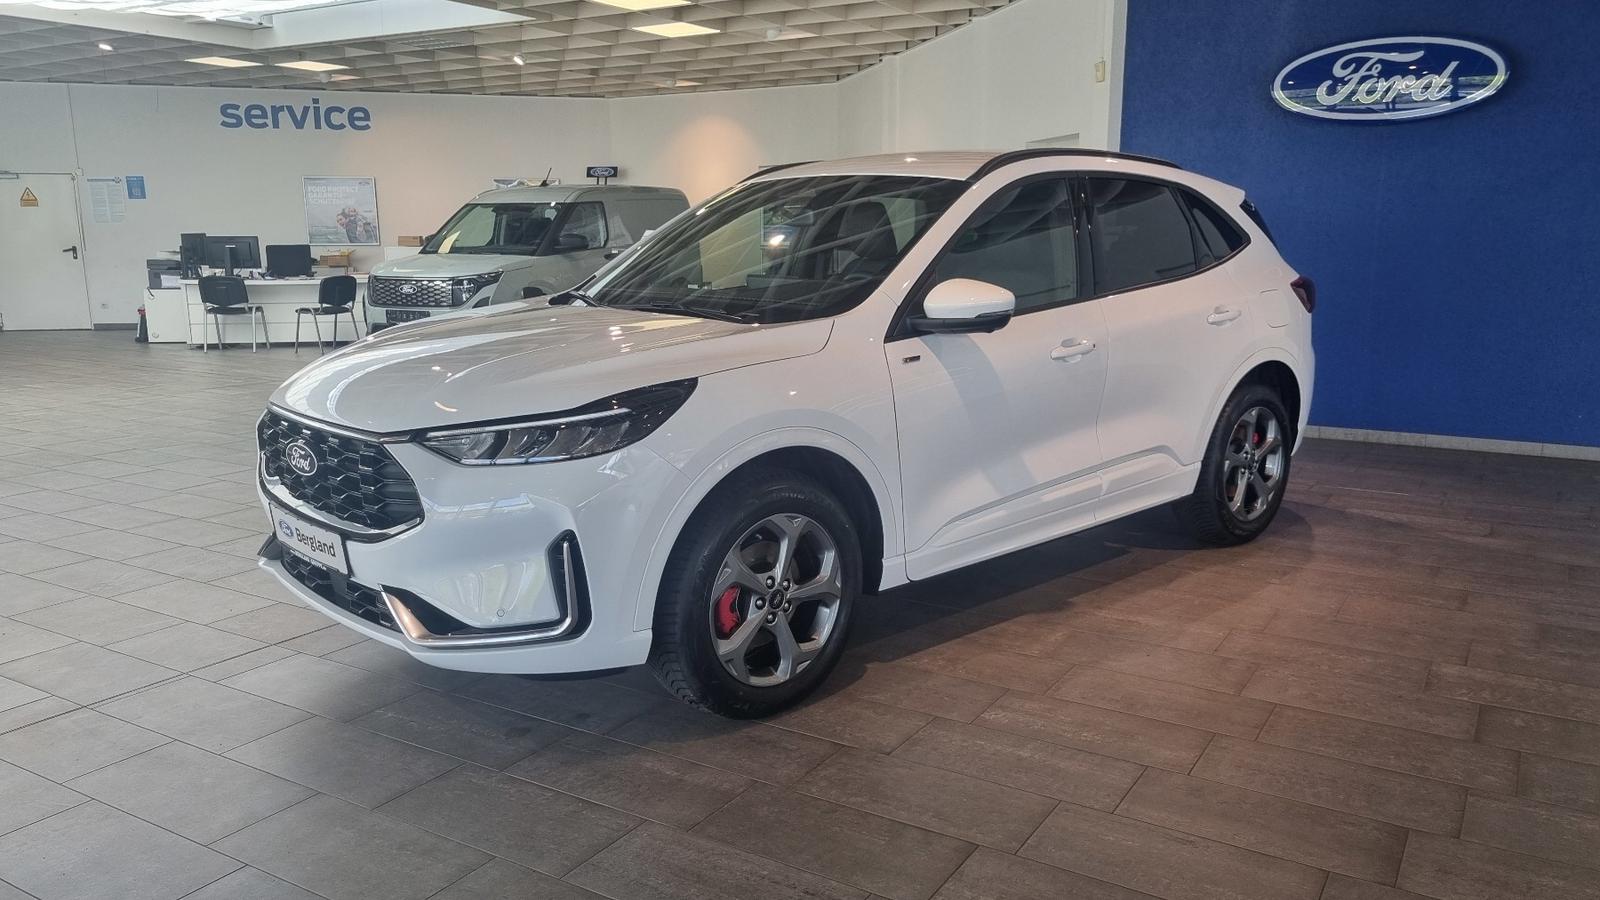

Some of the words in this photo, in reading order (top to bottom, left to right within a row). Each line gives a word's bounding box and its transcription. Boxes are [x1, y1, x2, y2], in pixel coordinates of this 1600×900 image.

[1316, 50, 1460, 106] Ford
[219, 97, 372, 131] service
[290, 446, 311, 472] Ford
[295, 526, 337, 558] Bergland
